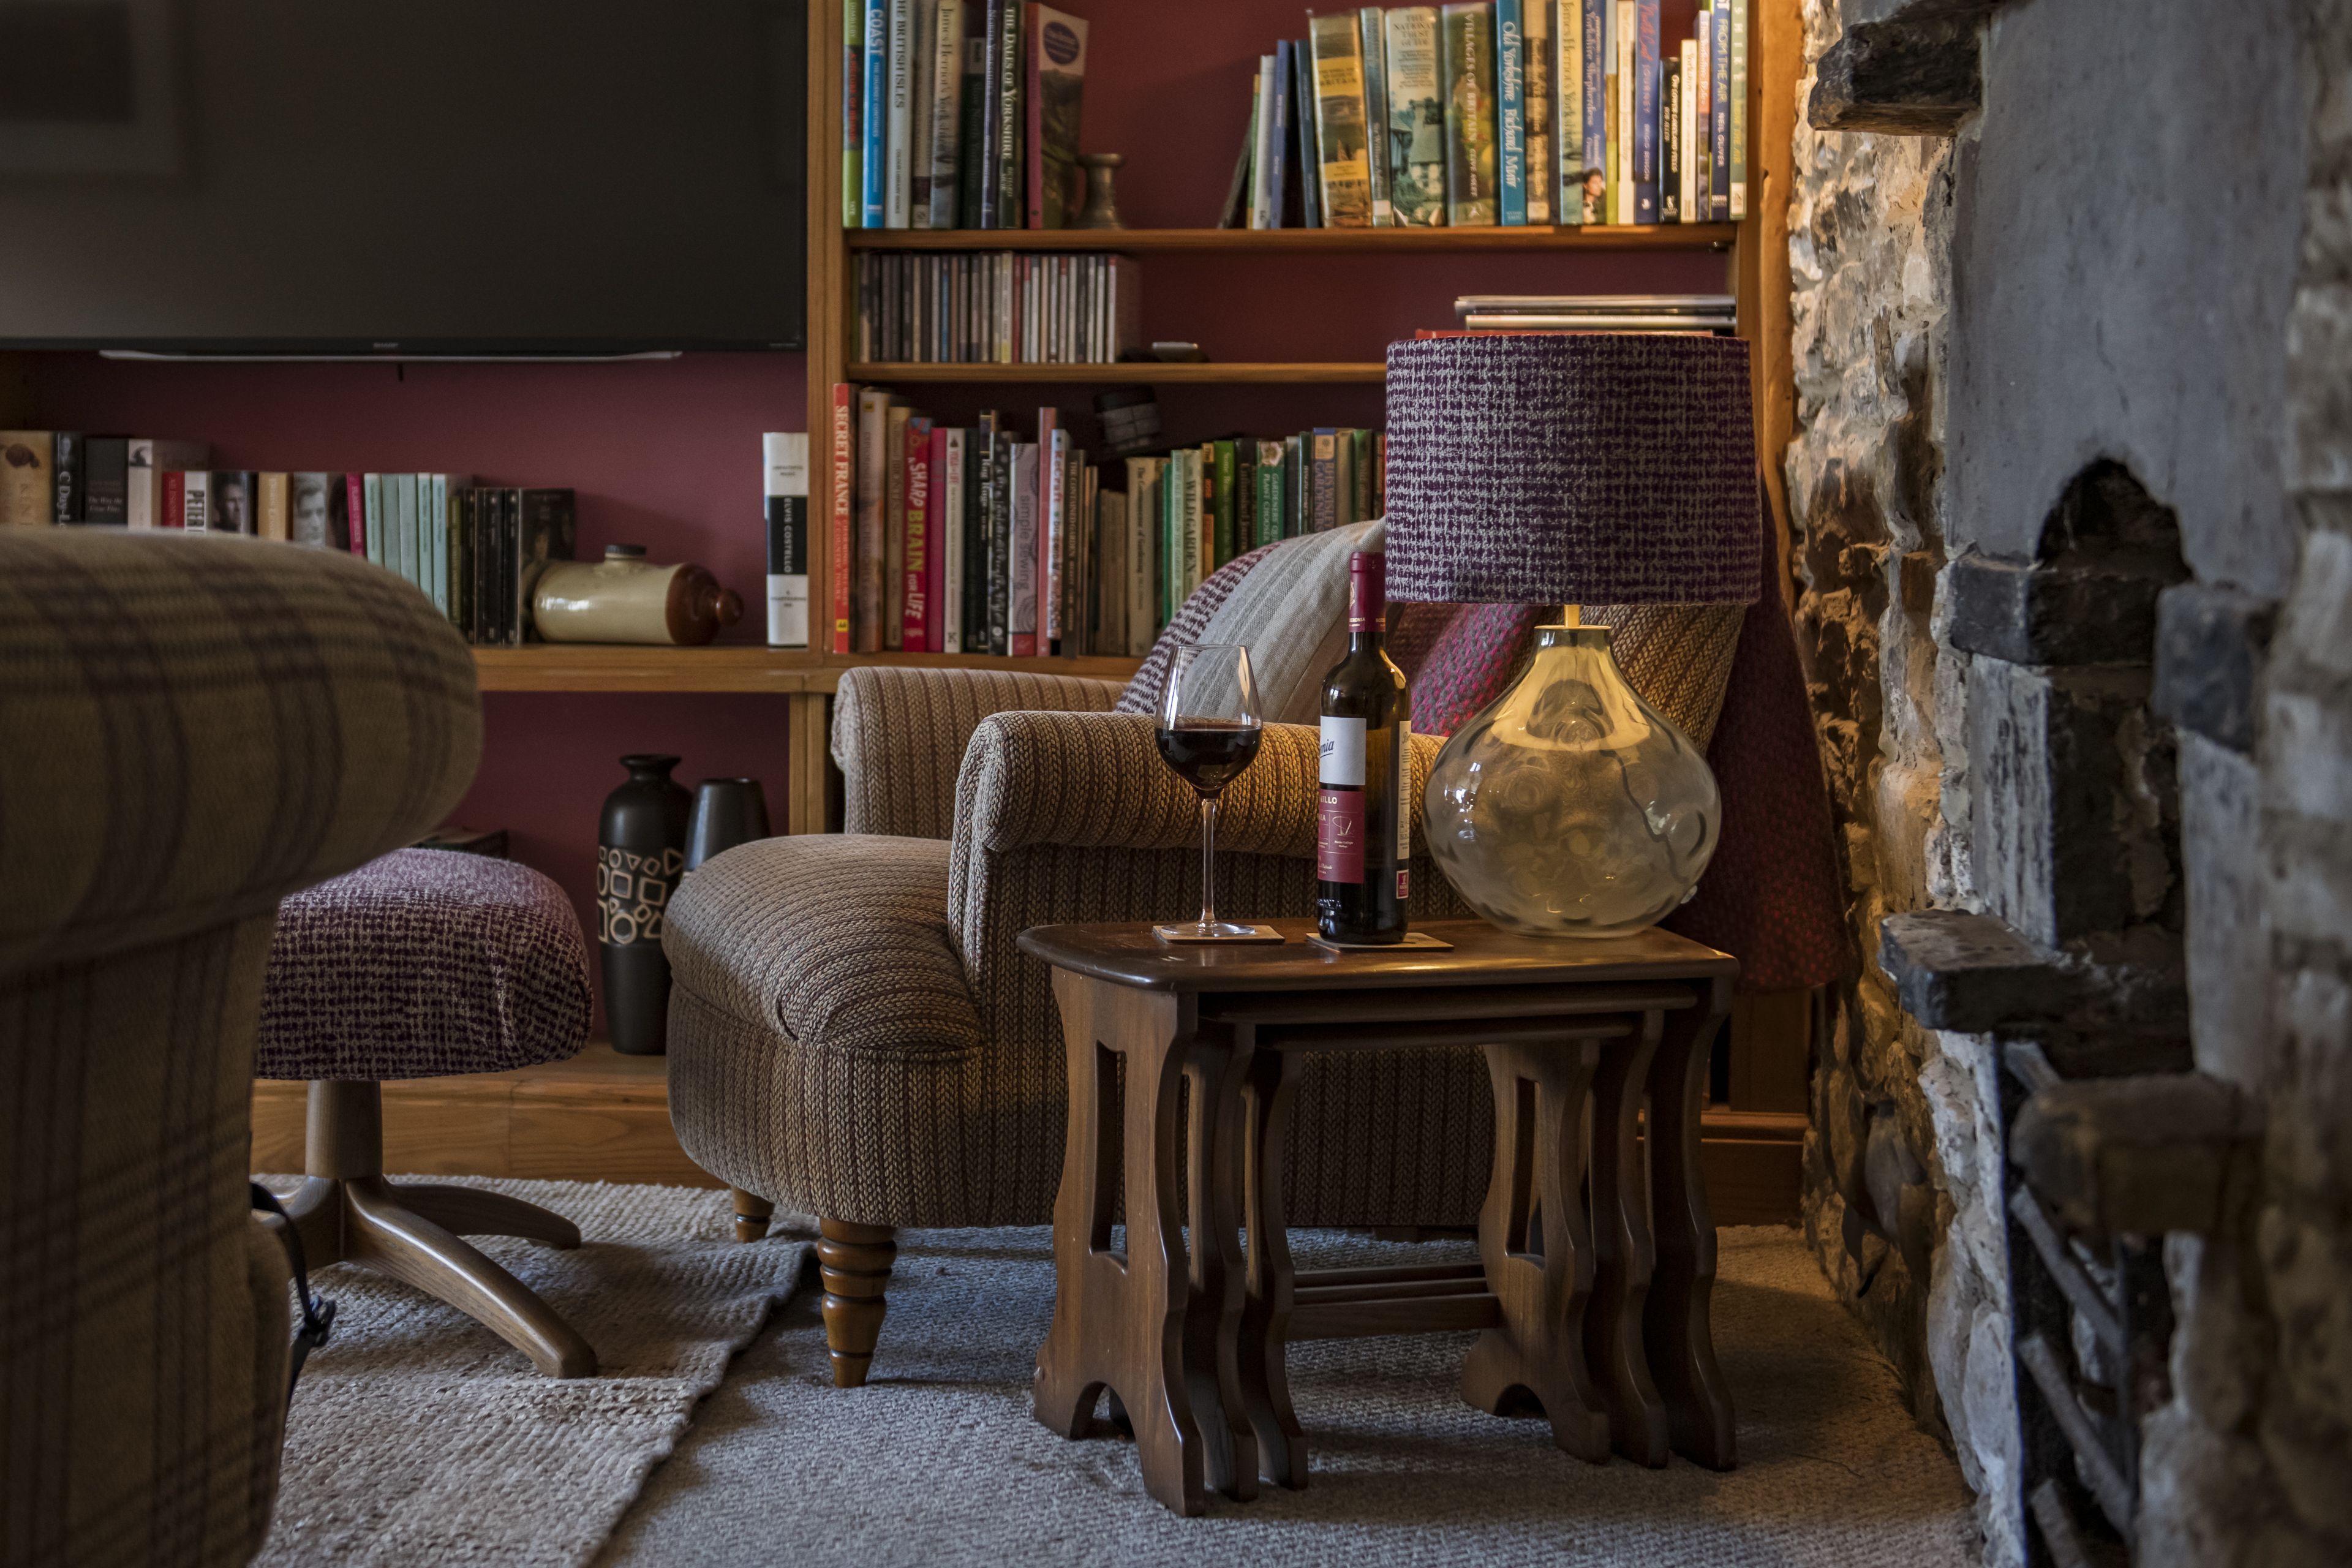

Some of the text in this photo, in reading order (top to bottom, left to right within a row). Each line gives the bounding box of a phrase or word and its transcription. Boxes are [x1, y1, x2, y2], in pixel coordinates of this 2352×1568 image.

[869, 9, 885, 56] COAST
[940, 8, 954, 41] James
[1561, 1, 1576, 36] James
[1585, 11, 1596, 61] Yorkshire
[1717, 18, 1728, 55] FROM
[895, 0, 907, 109] HE BRITISH ISLES
[940, 44, 954, 94] Herriot's
[1464, 13, 1479, 142] VILLAGES OF BRITAIN
[1561, 38, 1577, 89] Herriot's
[1717, 56, 1728, 81] THE
[1001, 7, 1018, 160] THE DALES OF YORKSHIRE
[1501, 21, 1524, 189] Old Yorkshire Richard Muir
[1583, 62, 1597, 127] Shepherdess
[1642, 64, 1652, 113] JOURNEY
[1717, 83, 1728, 104] AIR
[1469, 148, 1477, 172] CLIVE
[835, 404, 849, 516] SECRET FRANCE
[908, 462, 929, 507] SHARP
[186, 489, 205, 527] PETER
[1263, 473, 1272, 499] PLANT
[784, 497, 793, 573] ELVIS COSTELLO
[907, 509, 925, 571] BRAIN
[1016, 495, 1033, 590] simple sewing
[1185, 480, 1197, 573] WILD GARDEN
[905, 592, 925, 620] LIFE
[908, 573, 918, 591] FOR
